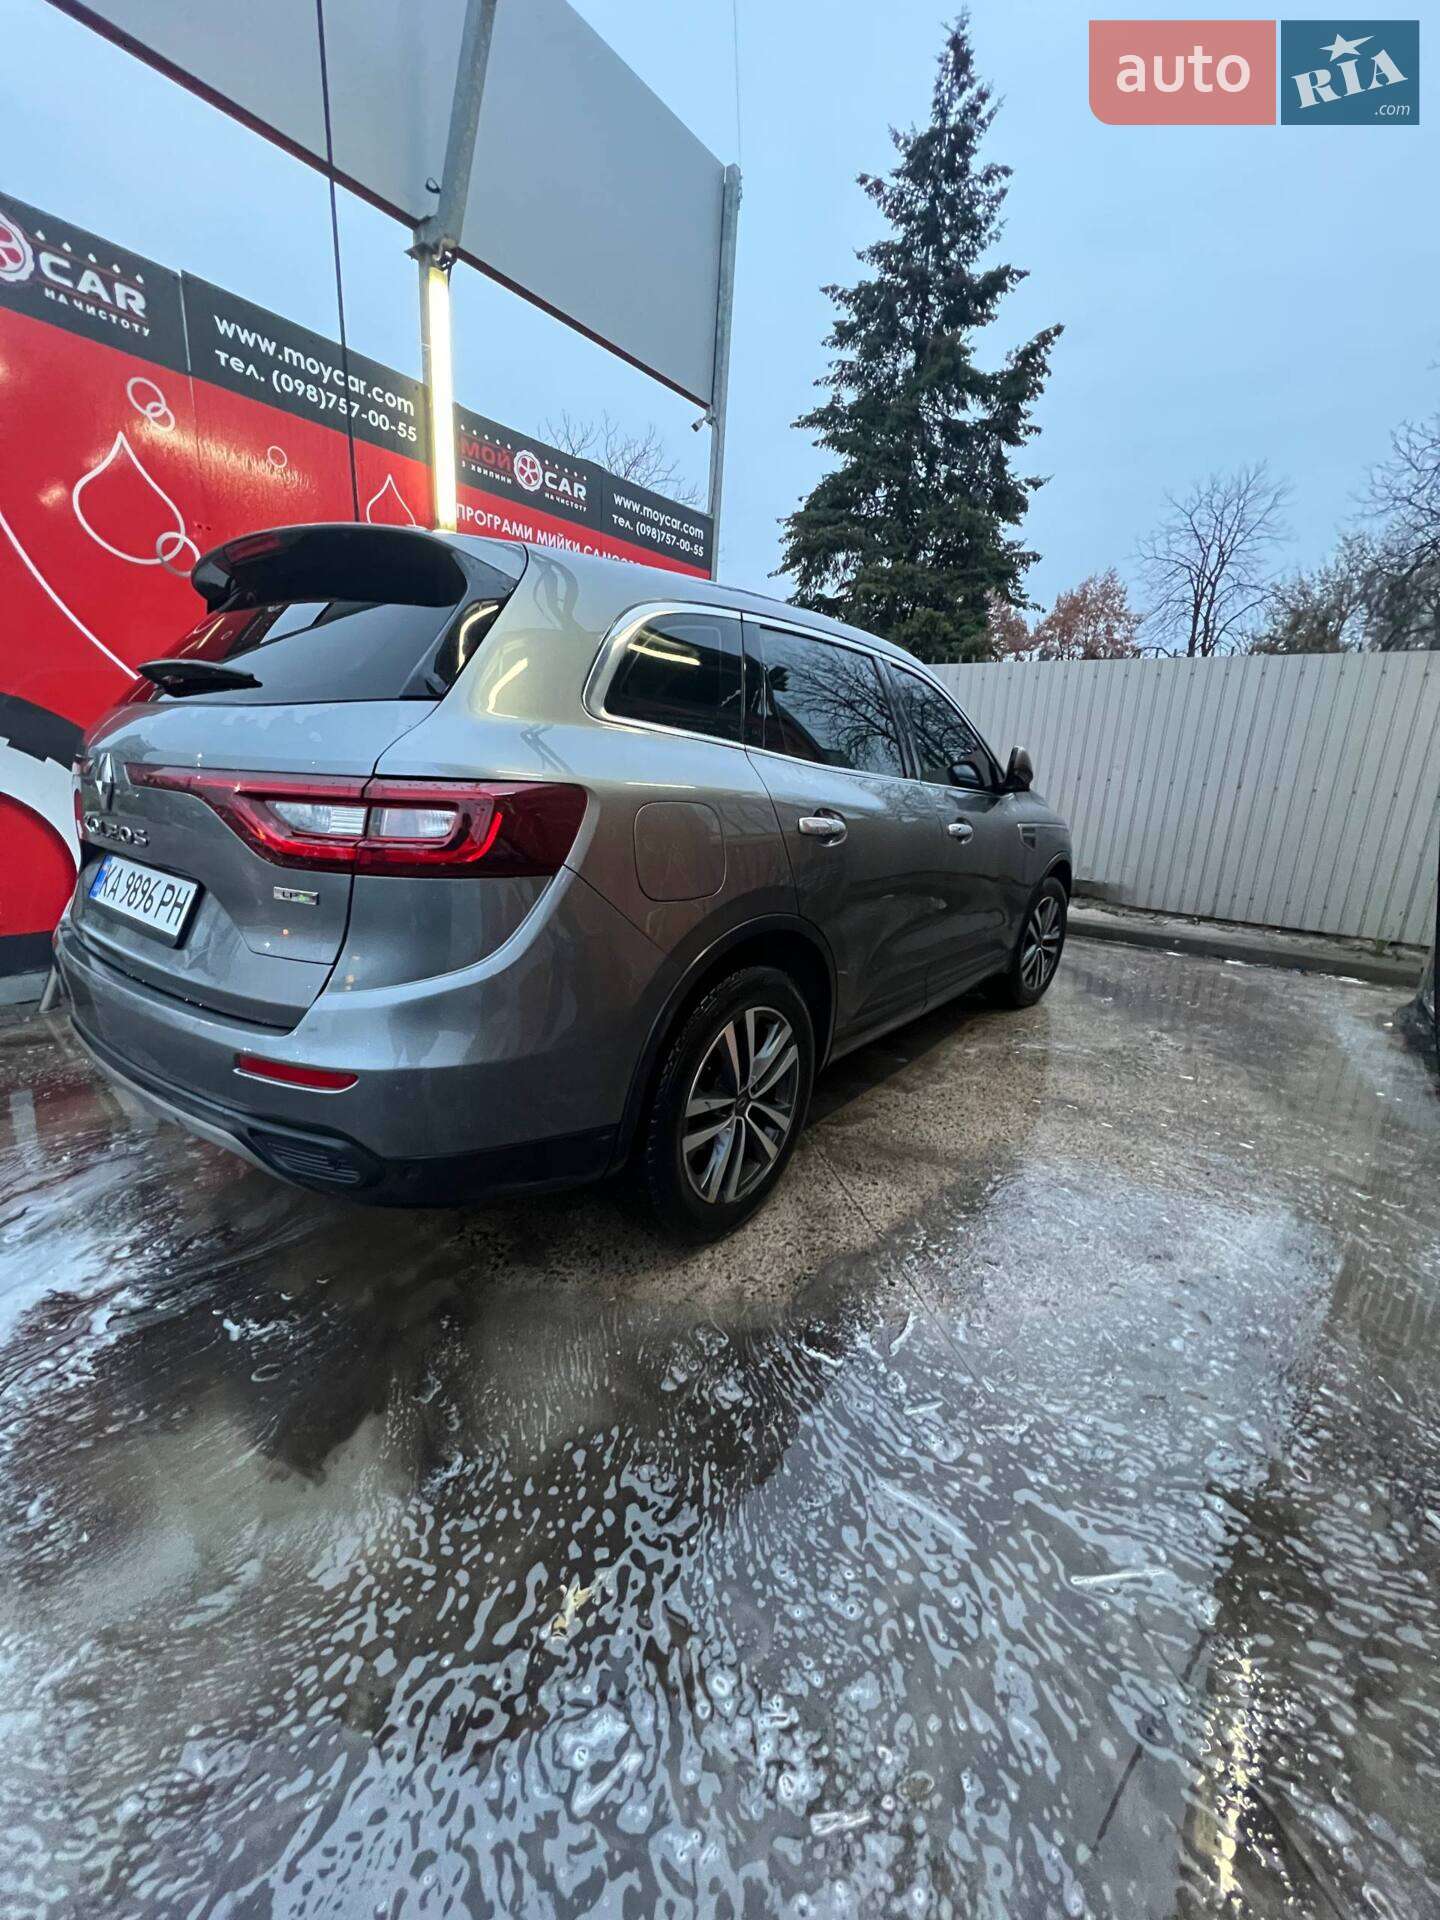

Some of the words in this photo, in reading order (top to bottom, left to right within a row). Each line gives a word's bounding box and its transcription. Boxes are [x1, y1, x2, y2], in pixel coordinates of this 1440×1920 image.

[39, 251, 147, 318] CAR
[213, 315, 415, 416] www.moycar.com
[214, 349, 266, 382] тел.
[272, 370, 418, 442] (098)757-00-55
[544, 471, 587, 501] CAR
[456, 503, 533, 541] ПРОГРАМИ
[536, 531, 581, 553] МИЙКИ
[612, 514, 634, 531] тел.
[636, 521, 705, 557] (098)757-00-55
[613, 493, 705, 540] www.moycar.com
[119, 870, 162, 914] 9896
